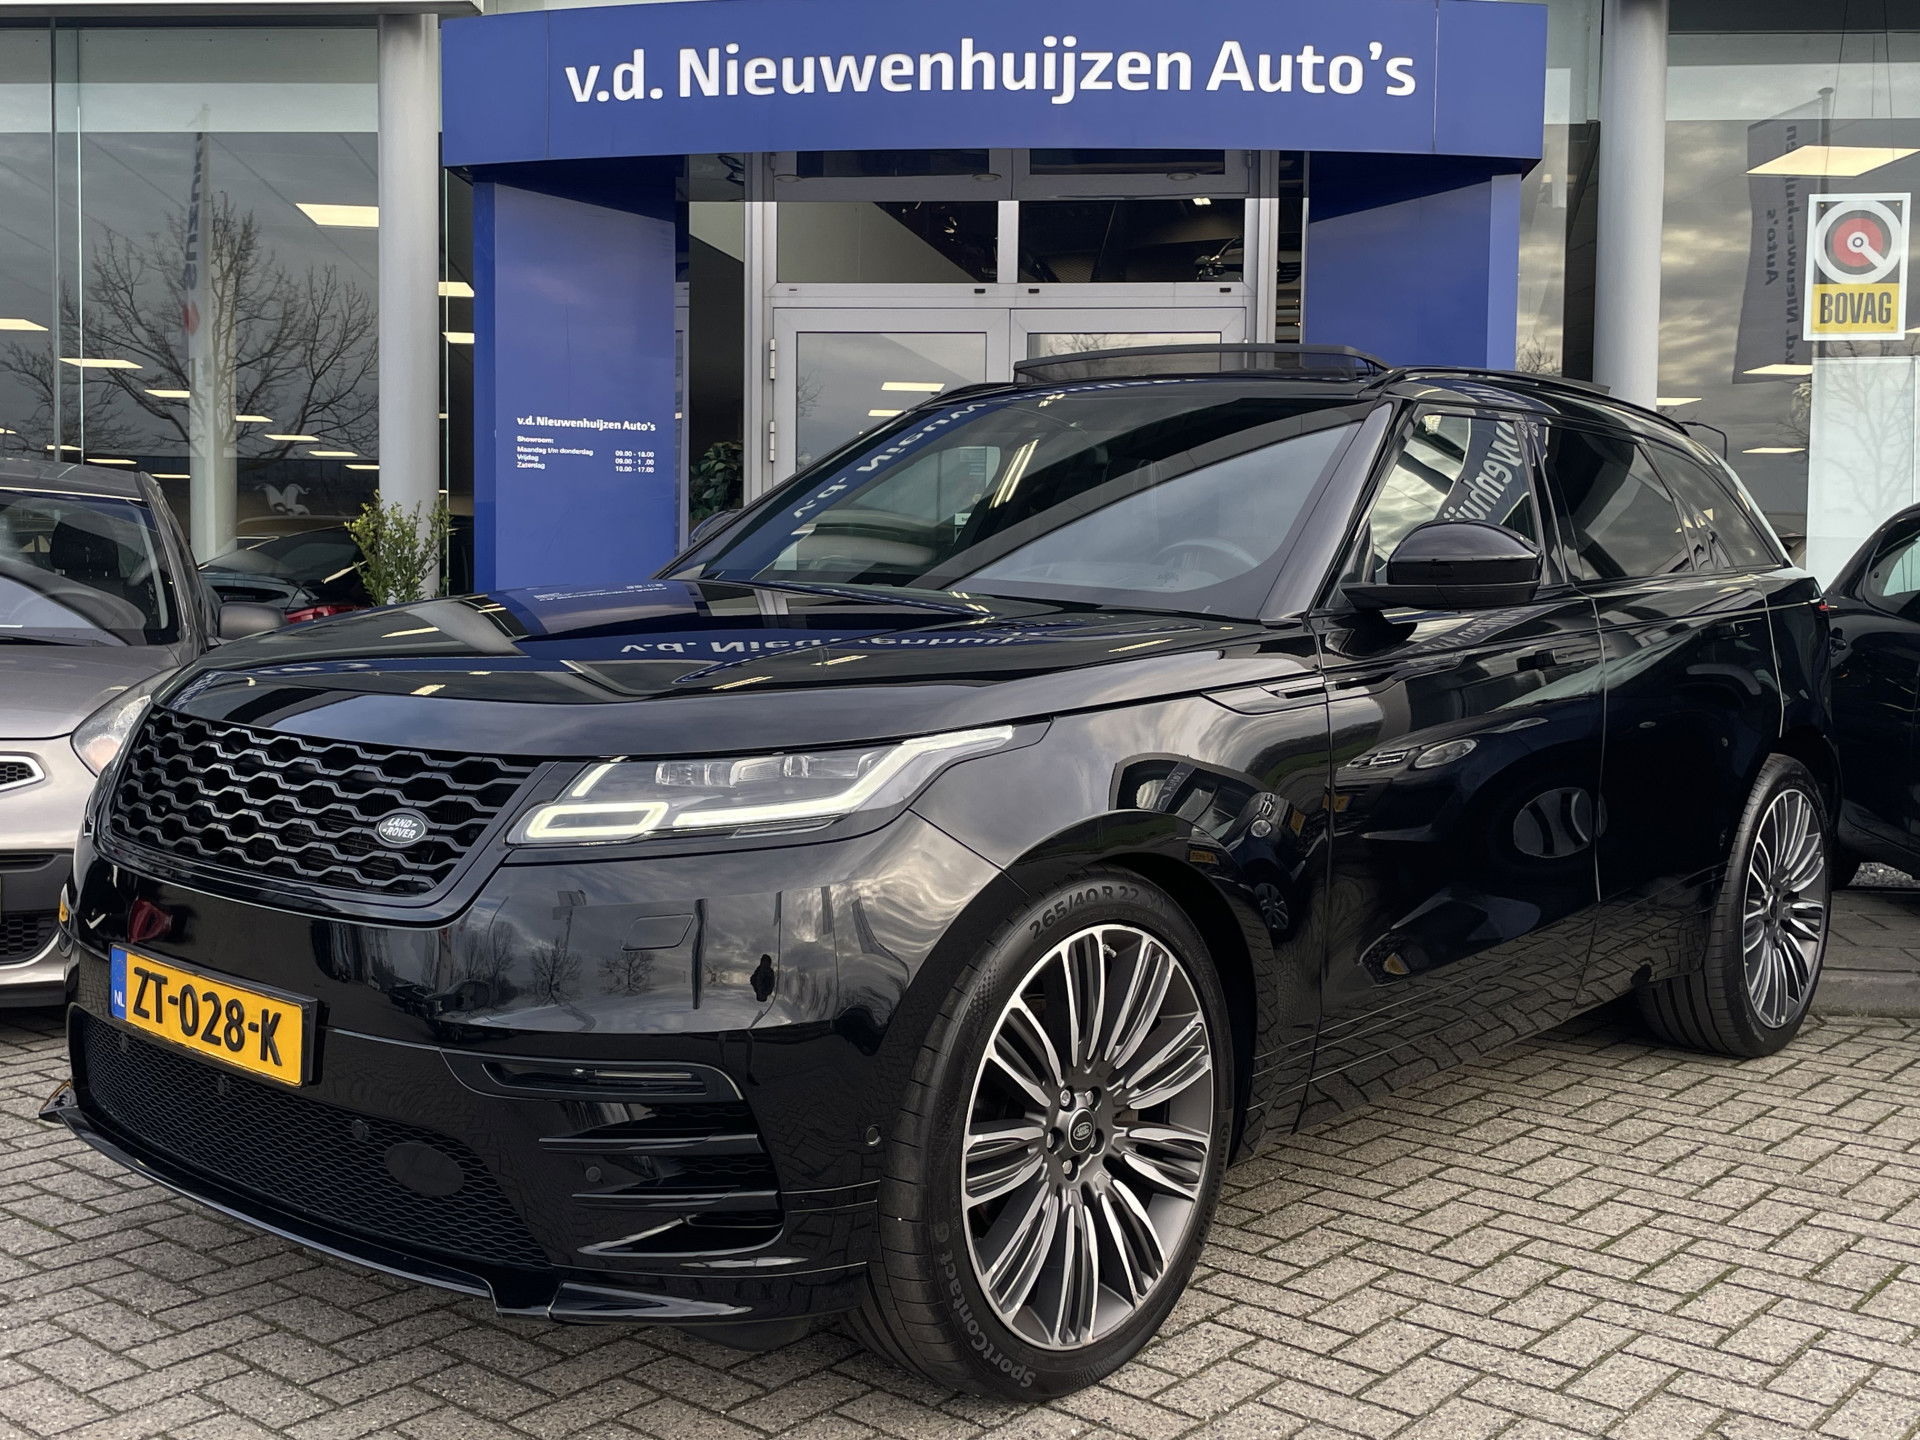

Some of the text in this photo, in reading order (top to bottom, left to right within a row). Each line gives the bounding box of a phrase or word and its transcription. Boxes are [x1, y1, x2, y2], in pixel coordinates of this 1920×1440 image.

[565, 36, 1416, 105] v.d. Nieuwenhuijzen Auto's
[1819, 292, 1892, 325] BOVAG
[516, 415, 656, 432] v.d. Nieuwenhuijzen Auto's
[516, 435, 554, 444] Showroom:
[516, 446, 547, 455] Maandag
[559, 447, 594, 457] donderdag
[516, 454, 539, 462] Vrijdag
[516, 461, 545, 470] Zaterdag
[1029, 887, 1098, 940] 265/40
[114, 989, 126, 1008] NL
[133, 966, 283, 1067] ZT-028-K
[939, 1250, 1037, 1388] SportContact
